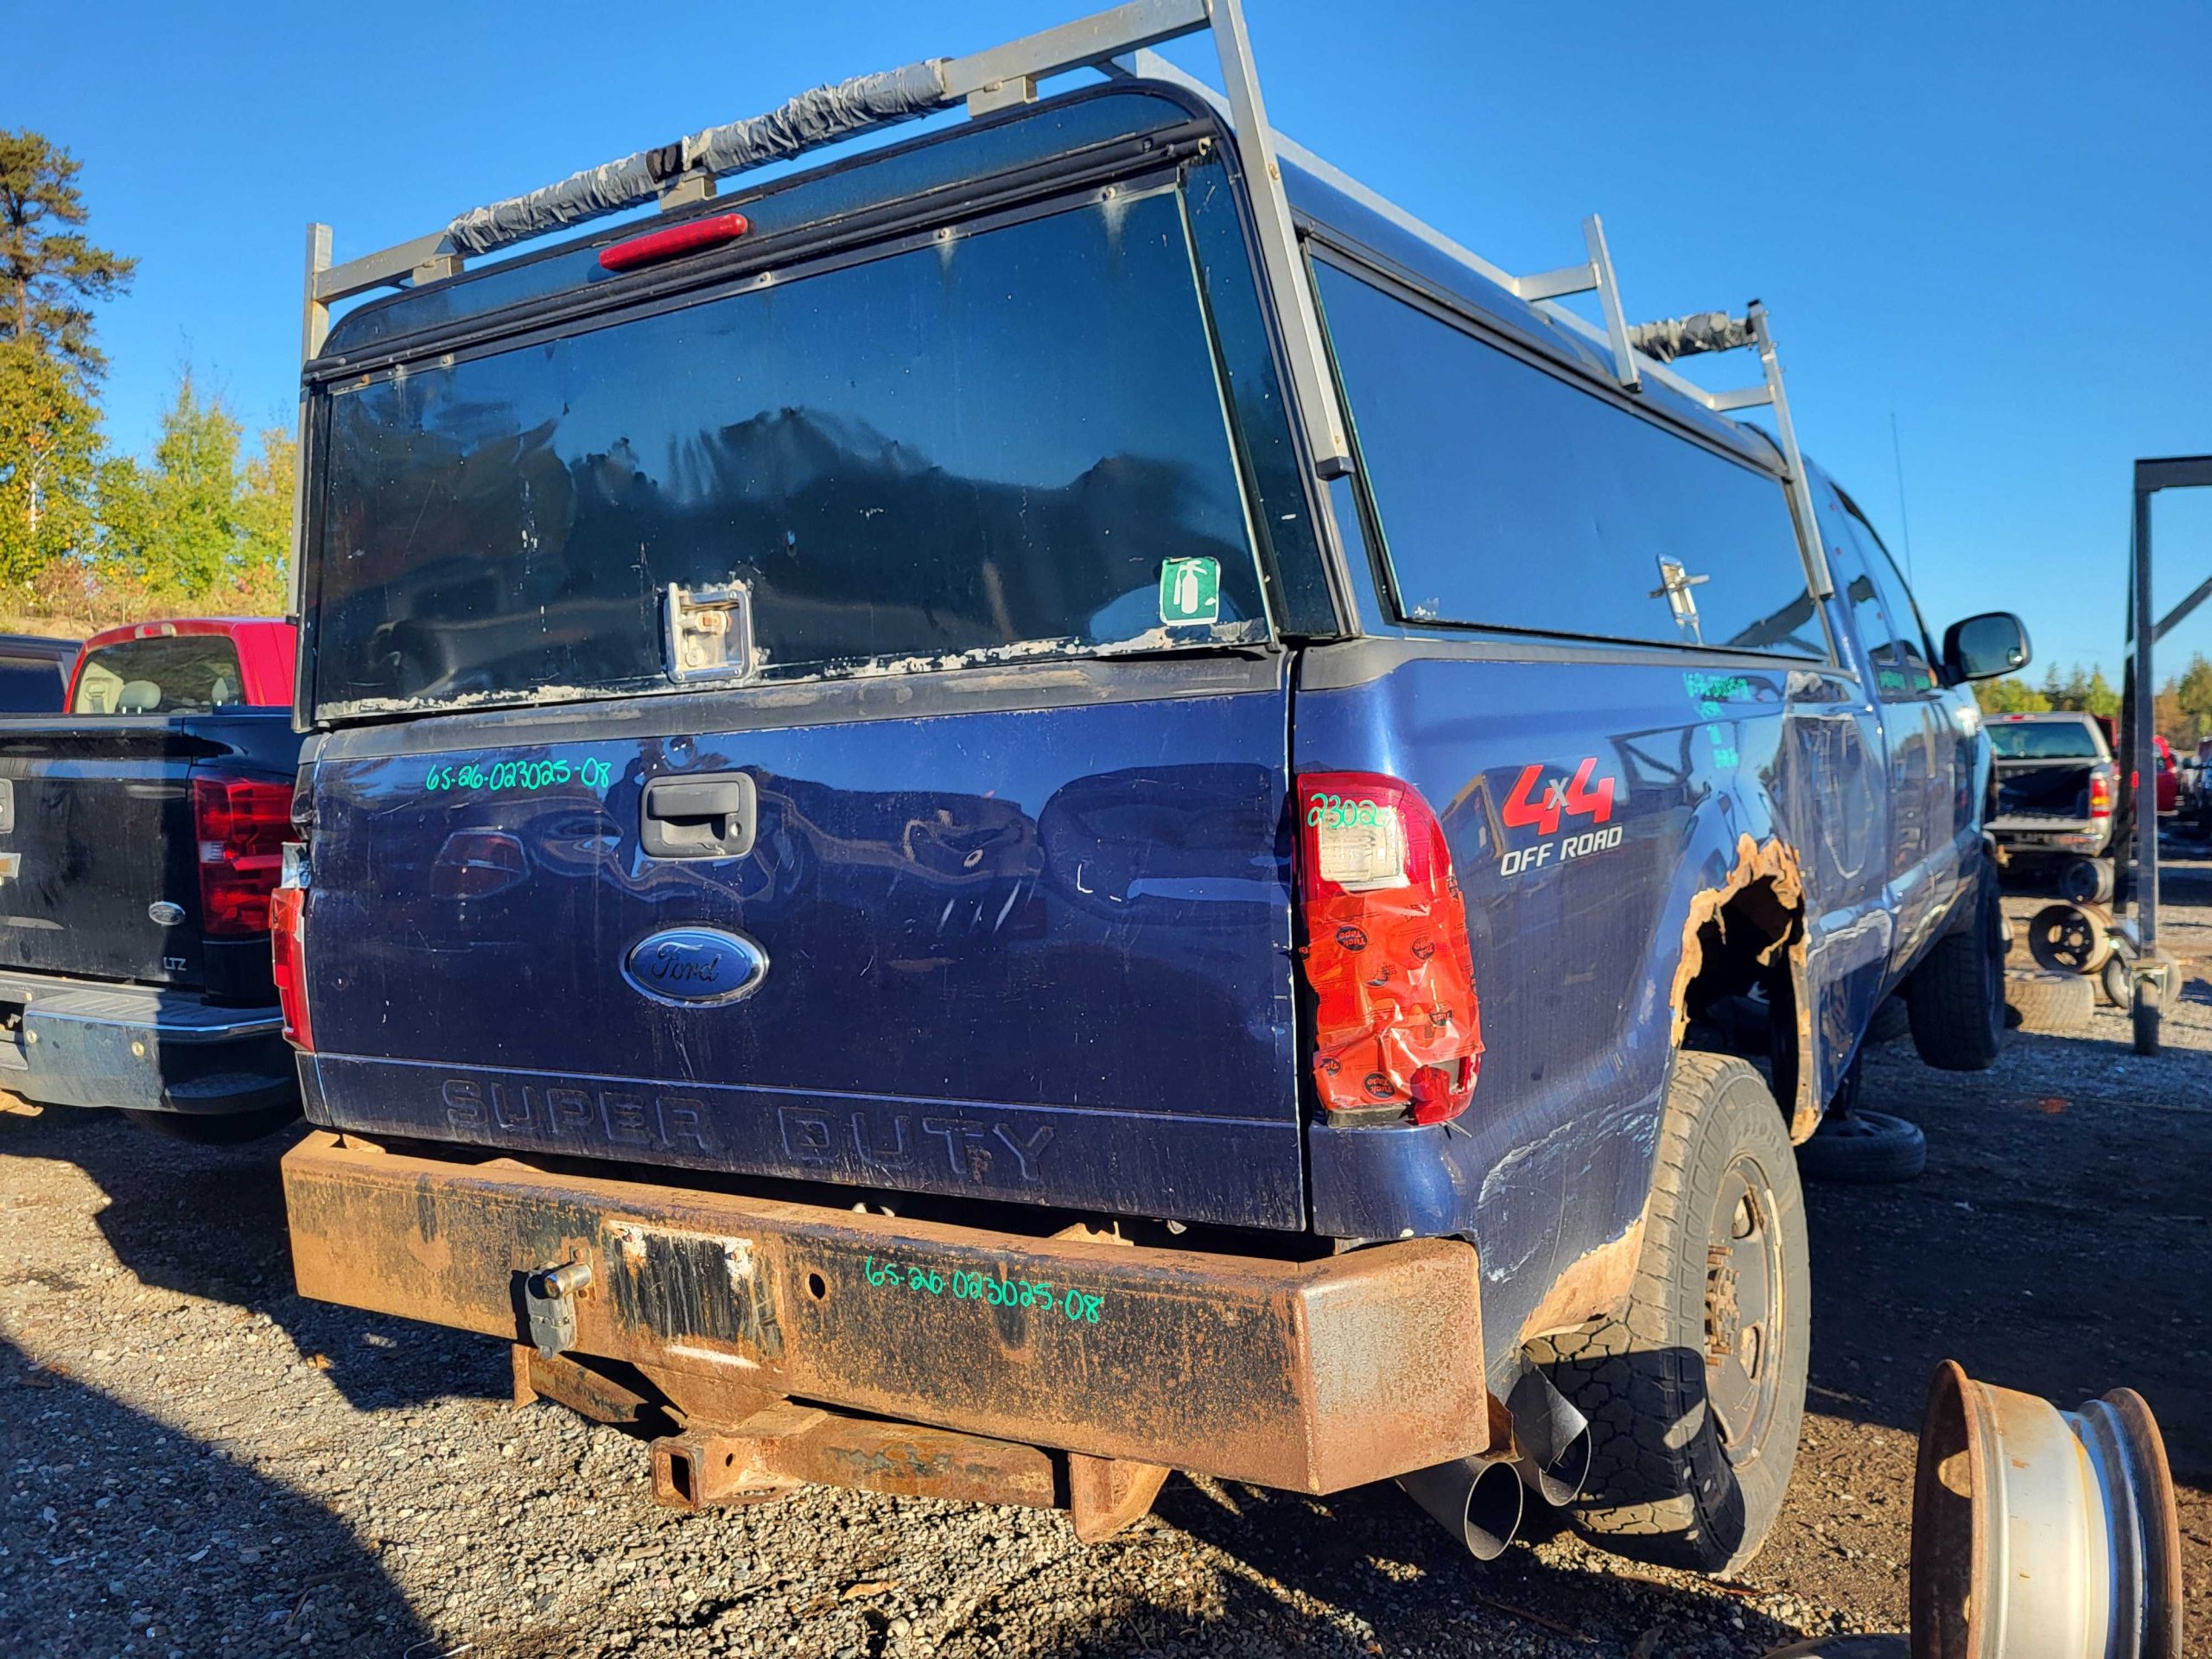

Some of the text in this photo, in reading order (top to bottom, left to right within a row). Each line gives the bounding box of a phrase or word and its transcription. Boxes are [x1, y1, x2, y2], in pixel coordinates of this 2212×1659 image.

[1500, 825, 1623, 877] OFF ROAD
[162, 957, 188, 971] LTZ
[652, 941, 721, 982] Ford
[442, 1078, 1055, 1181] SUPER DUTY
